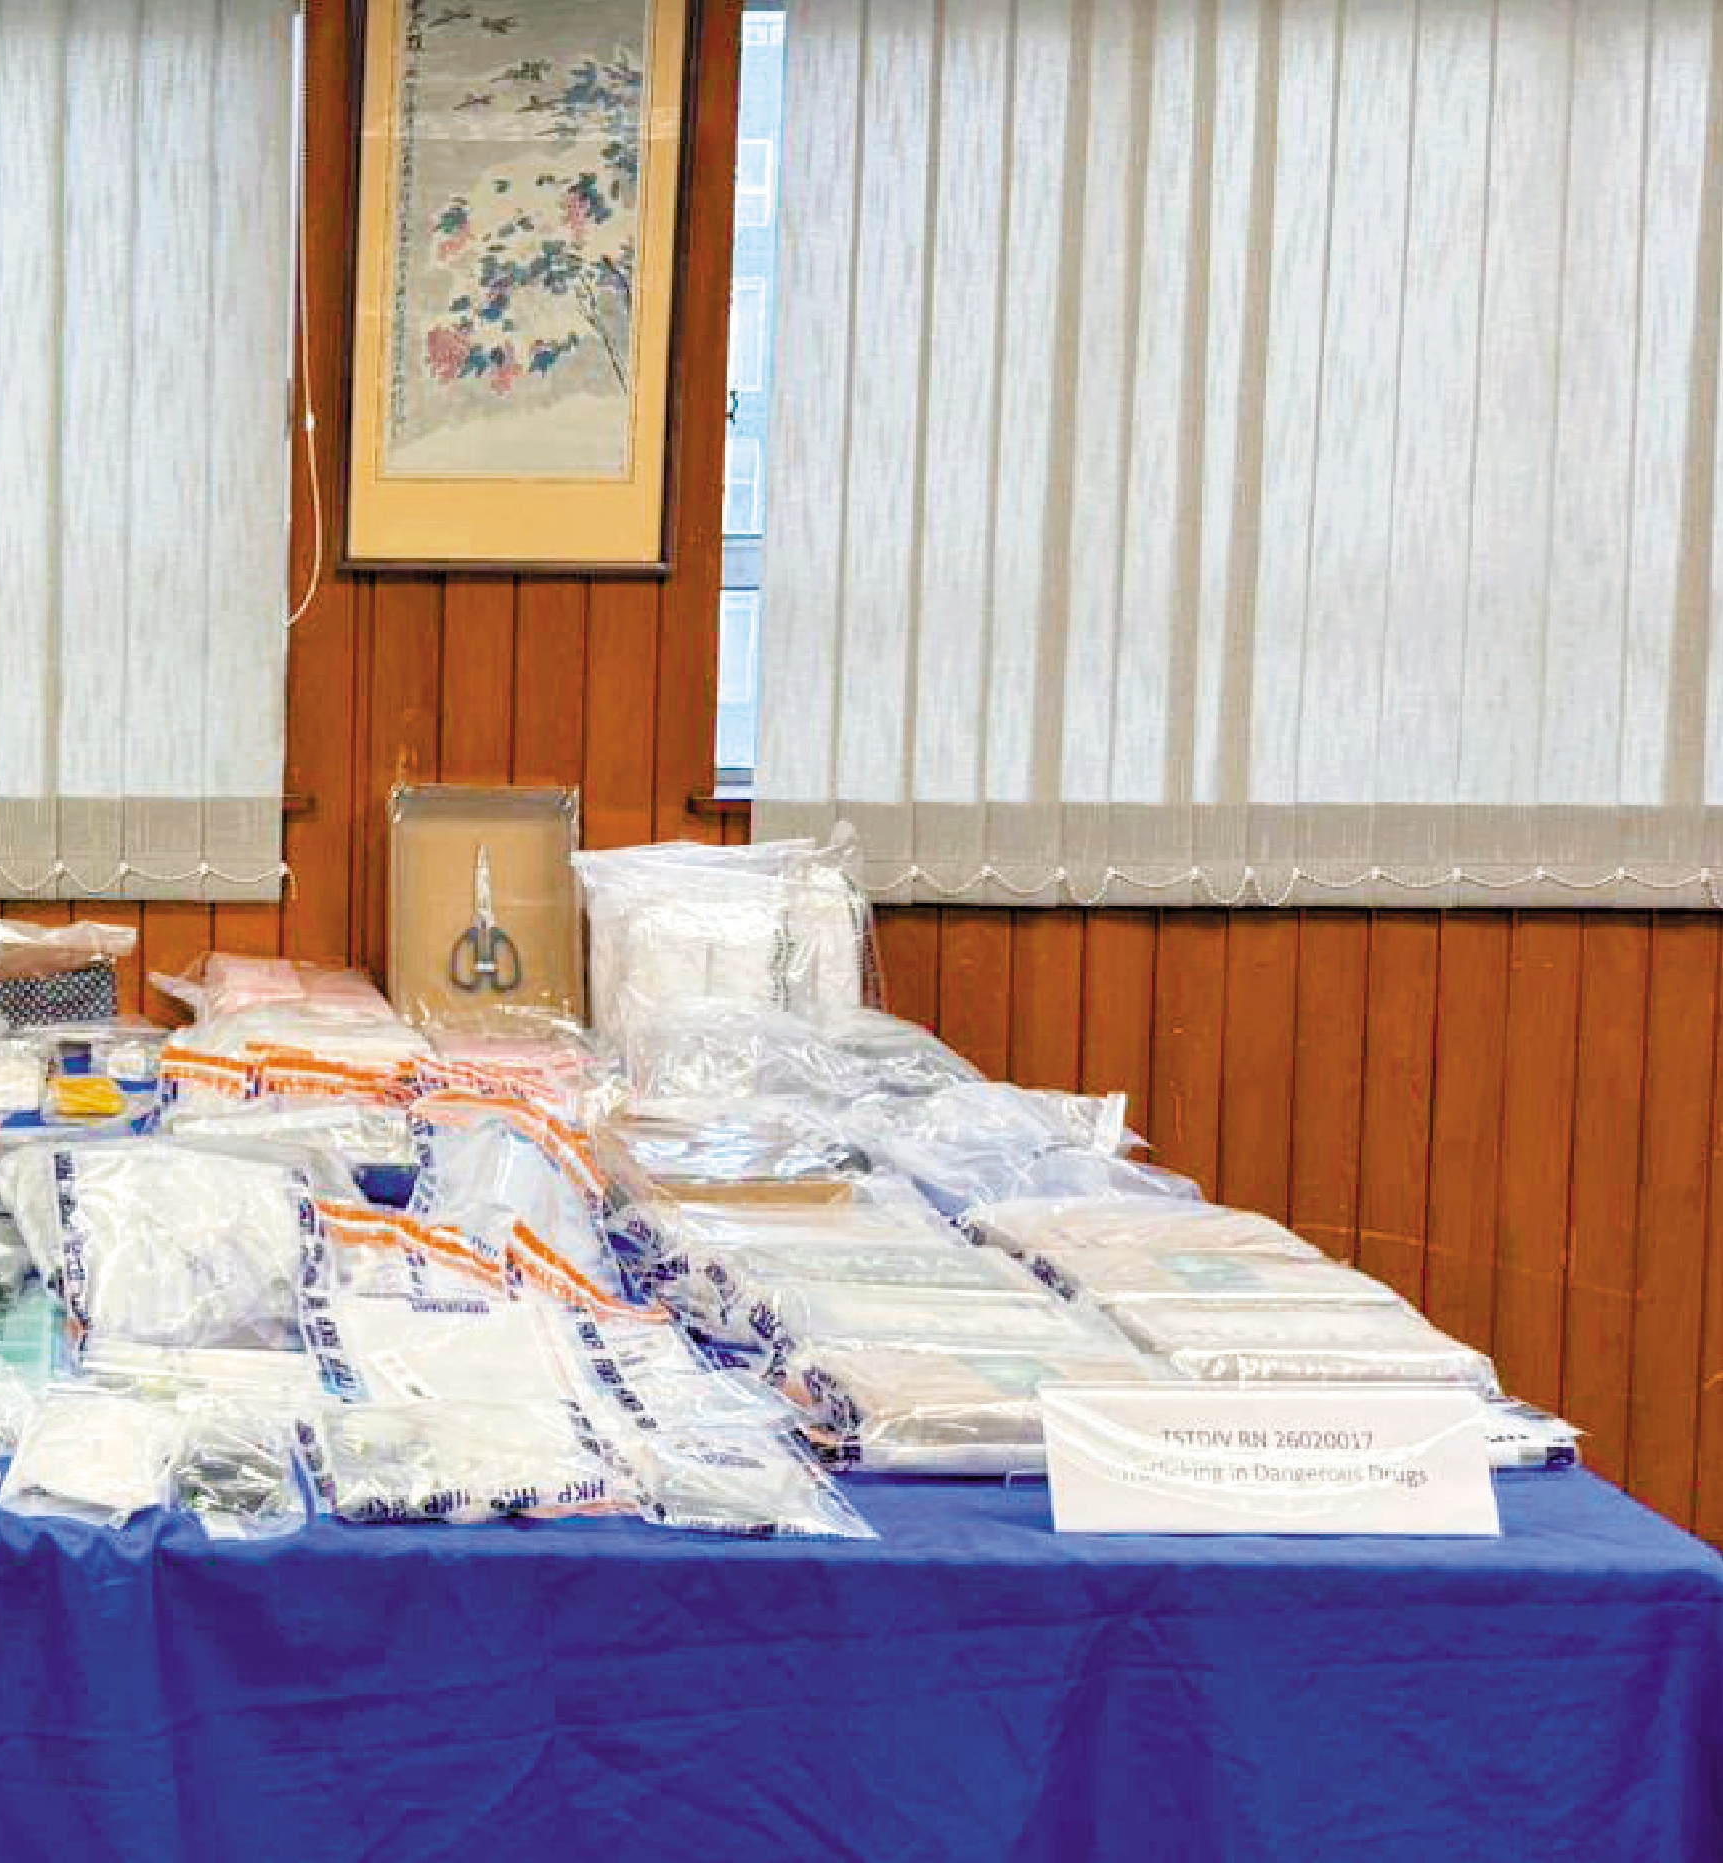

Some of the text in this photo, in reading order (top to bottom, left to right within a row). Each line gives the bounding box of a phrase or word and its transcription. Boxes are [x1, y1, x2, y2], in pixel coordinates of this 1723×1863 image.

[1163, 1430, 1374, 1450] TSTDIV RN 26020017
[1230, 1463, 1248, 1481] in
[1254, 1463, 1365, 1485] Dangerous
[1368, 1464, 1430, 1488] Drugs
[557, 1478, 605, 1504] HKP
